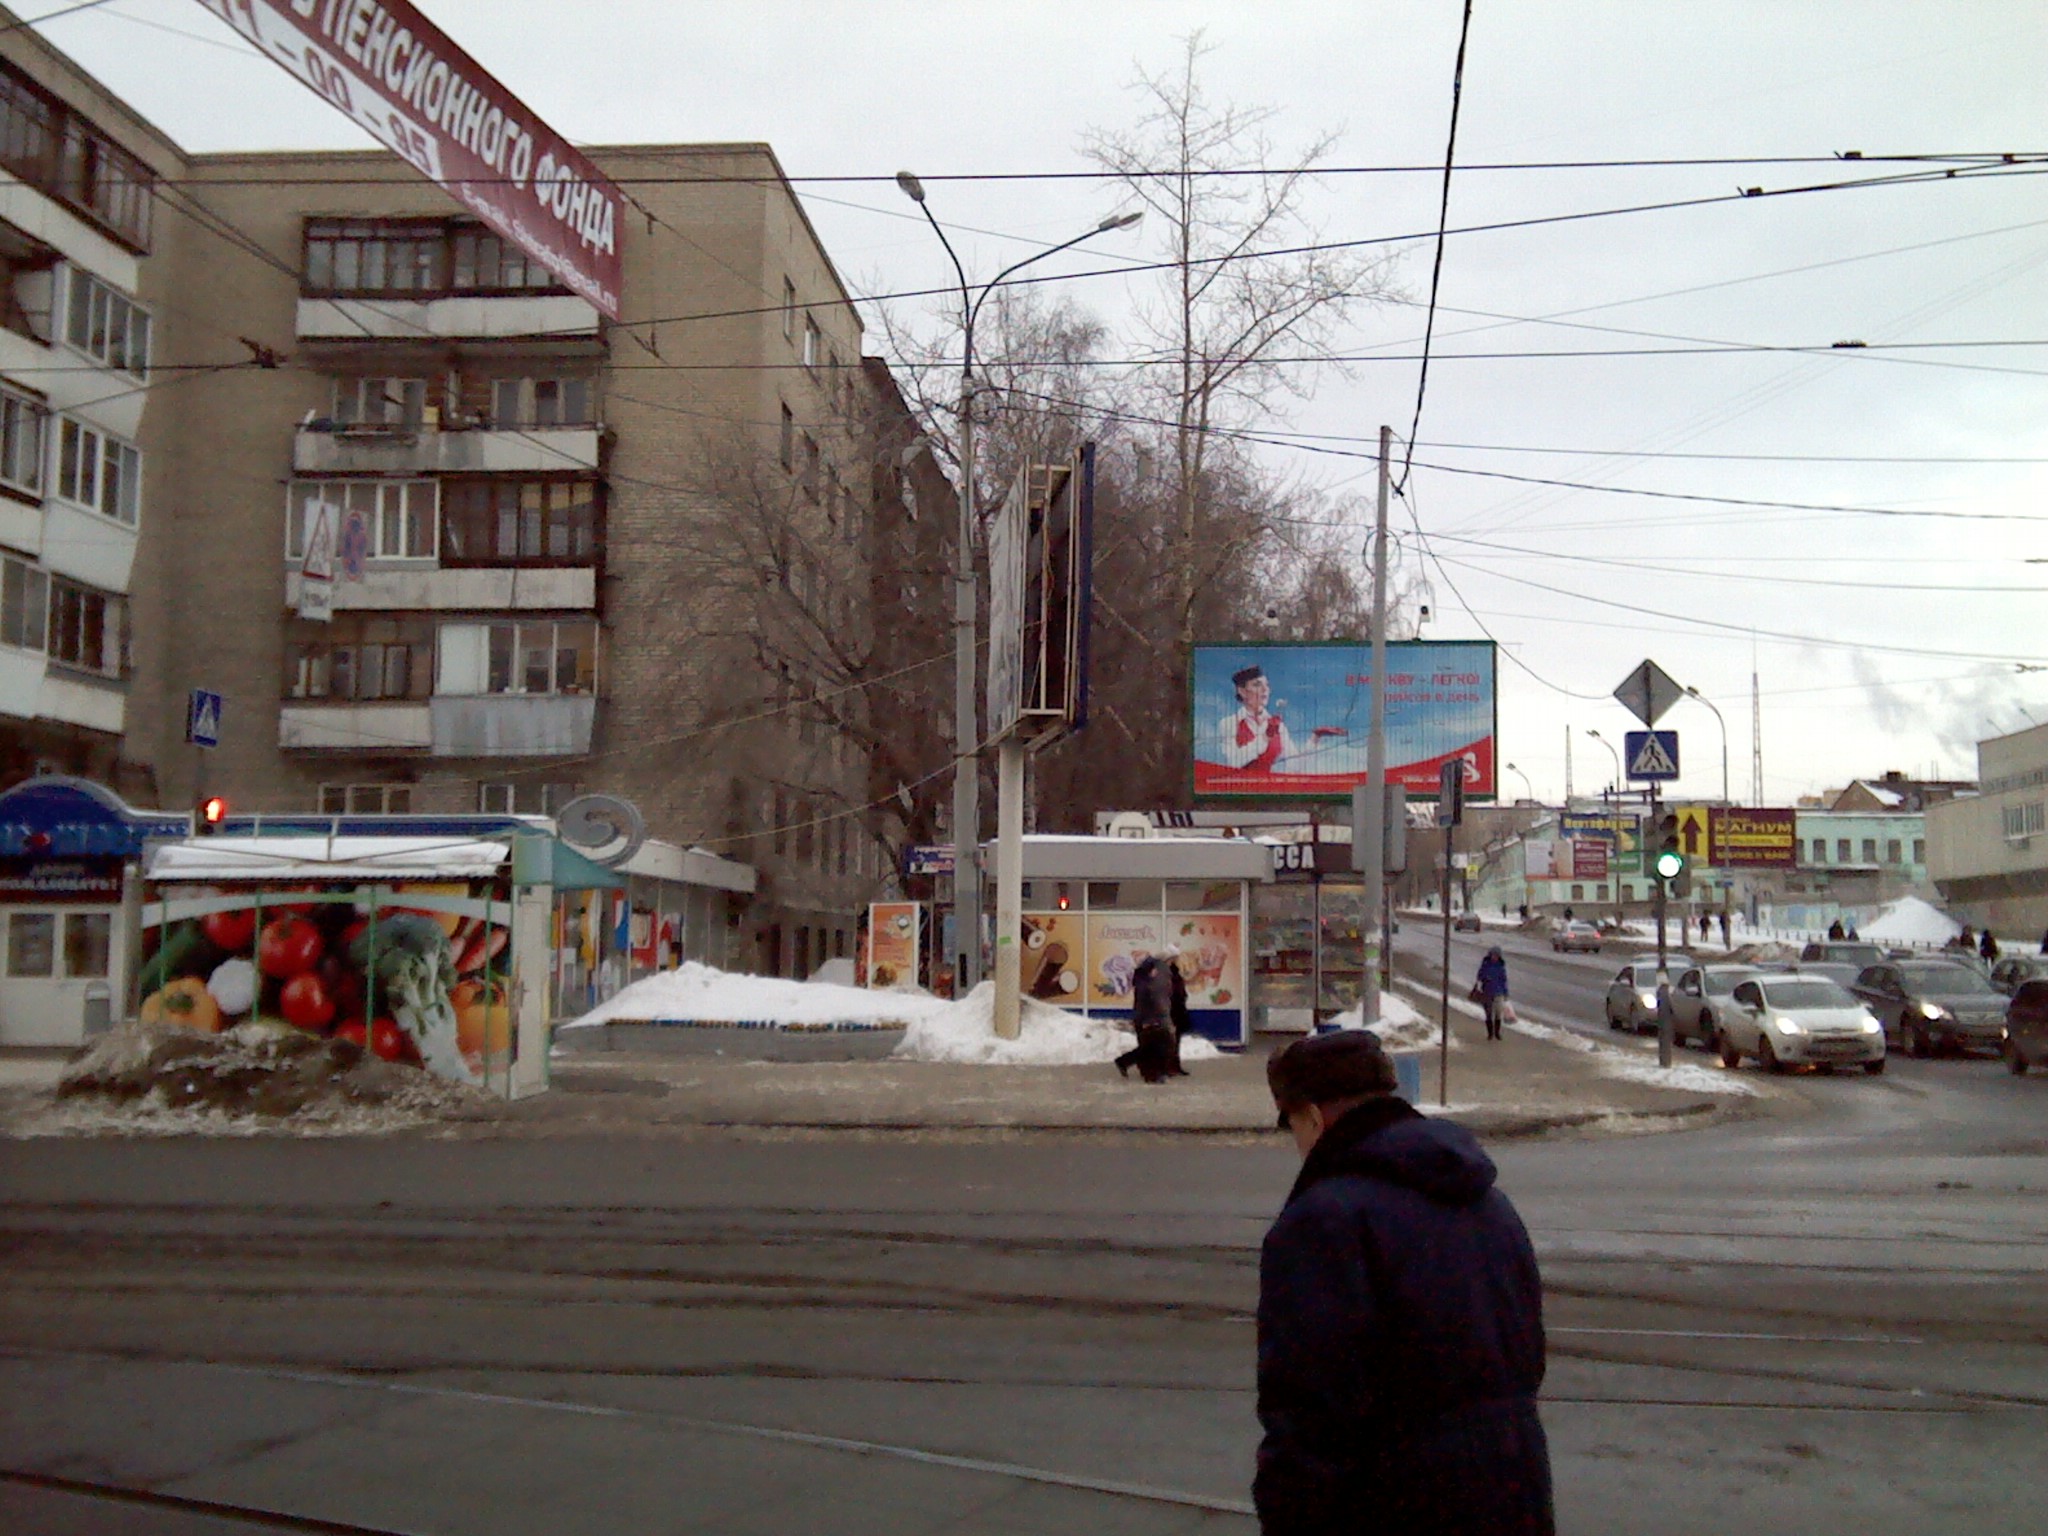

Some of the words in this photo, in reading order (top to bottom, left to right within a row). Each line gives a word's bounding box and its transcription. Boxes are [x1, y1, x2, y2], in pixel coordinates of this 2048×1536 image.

[322, 0, 534, 189] ПЕНСИОННОГО
[534, 152, 615, 256] ФОНДА
[1273, 845, 1315, 869] ССА
